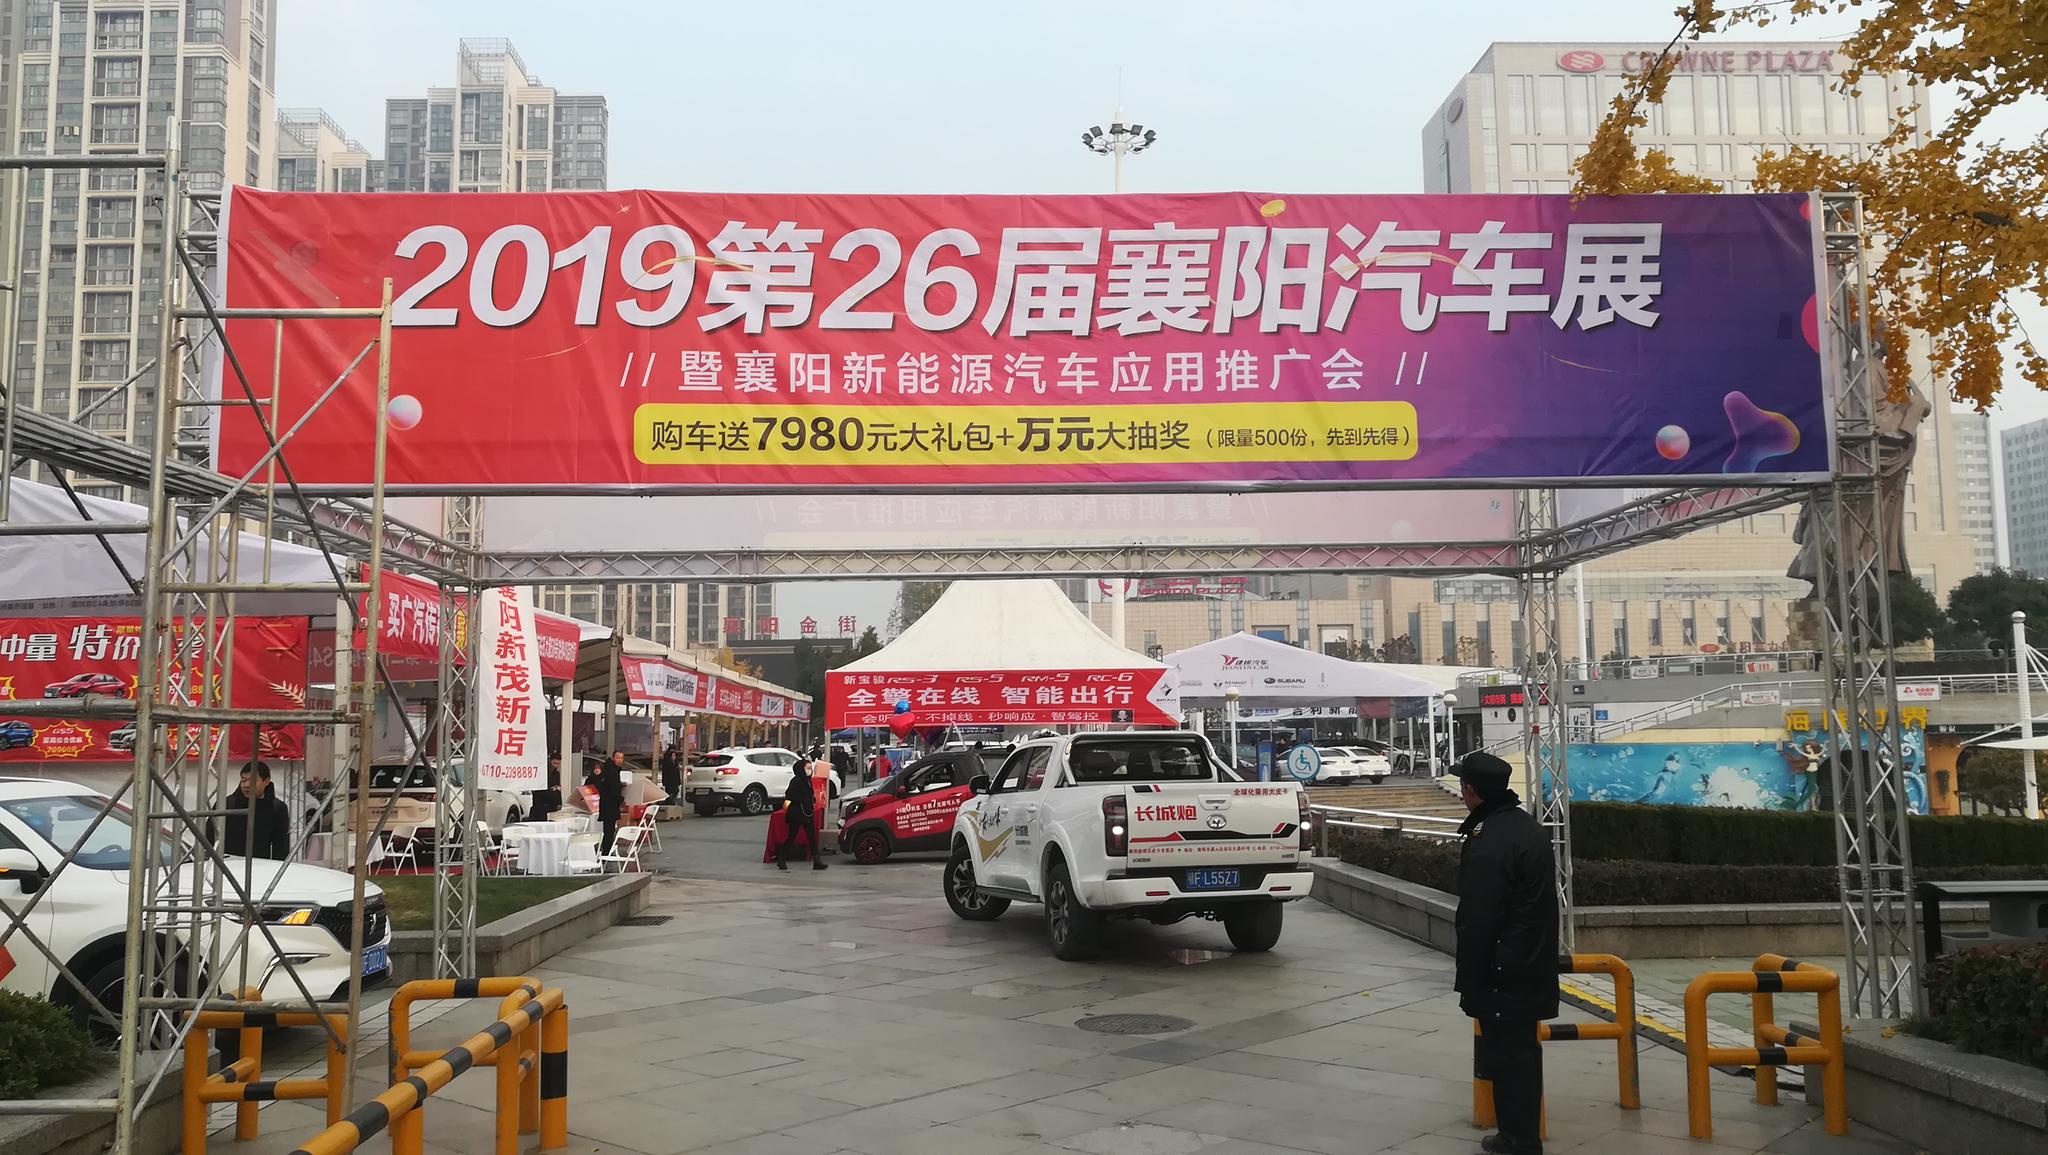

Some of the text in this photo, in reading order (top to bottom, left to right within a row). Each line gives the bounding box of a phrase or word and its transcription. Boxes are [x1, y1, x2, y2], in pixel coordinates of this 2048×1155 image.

[1621, 50, 1834, 73] CRWNE PLAZA
[391, 220, 1663, 335] 2019第26届襄阳汽车展
[678, 348, 1364, 394] 暨襄阳新能源汽车应用推广会
[651, 416, 1191, 453] 购车送7980元大礼包+万元大抽奖
[387, 592, 441, 647] 买广汽传
[955, 673, 1005, 684] RS-5
[1021, 672, 1071, 684] RM-5
[1086, 671, 1135, 683] RC-6
[1000, 684, 1135, 705] 智能出行
[1134, 805, 1198, 822] 长城炮
